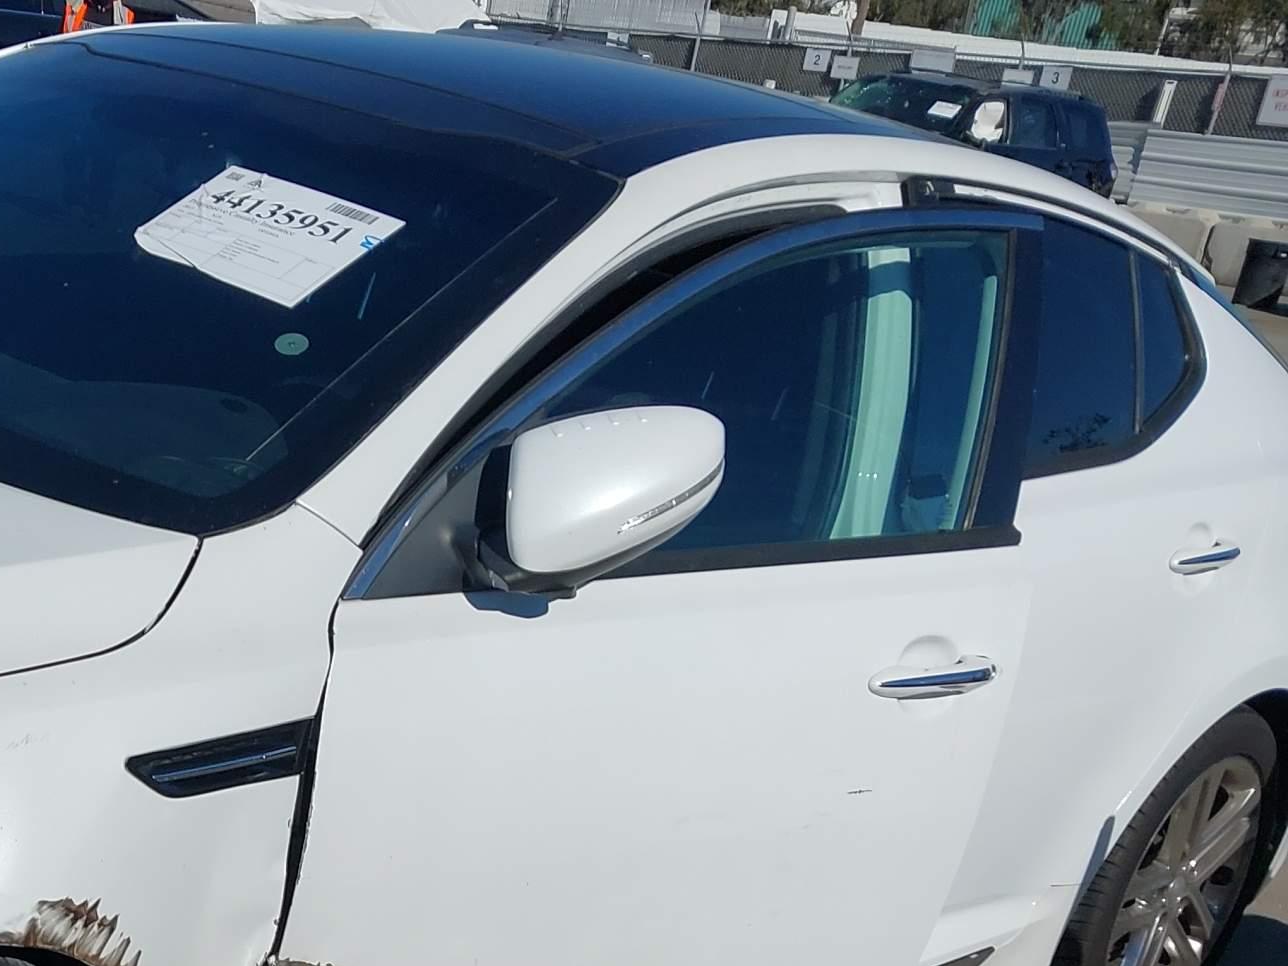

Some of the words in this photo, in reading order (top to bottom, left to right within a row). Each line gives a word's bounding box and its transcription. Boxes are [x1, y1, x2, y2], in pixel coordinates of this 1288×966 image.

[813, 54, 821, 66] 2
[1051, 71, 1060, 84] 3
[211, 189, 354, 245] 44135951
